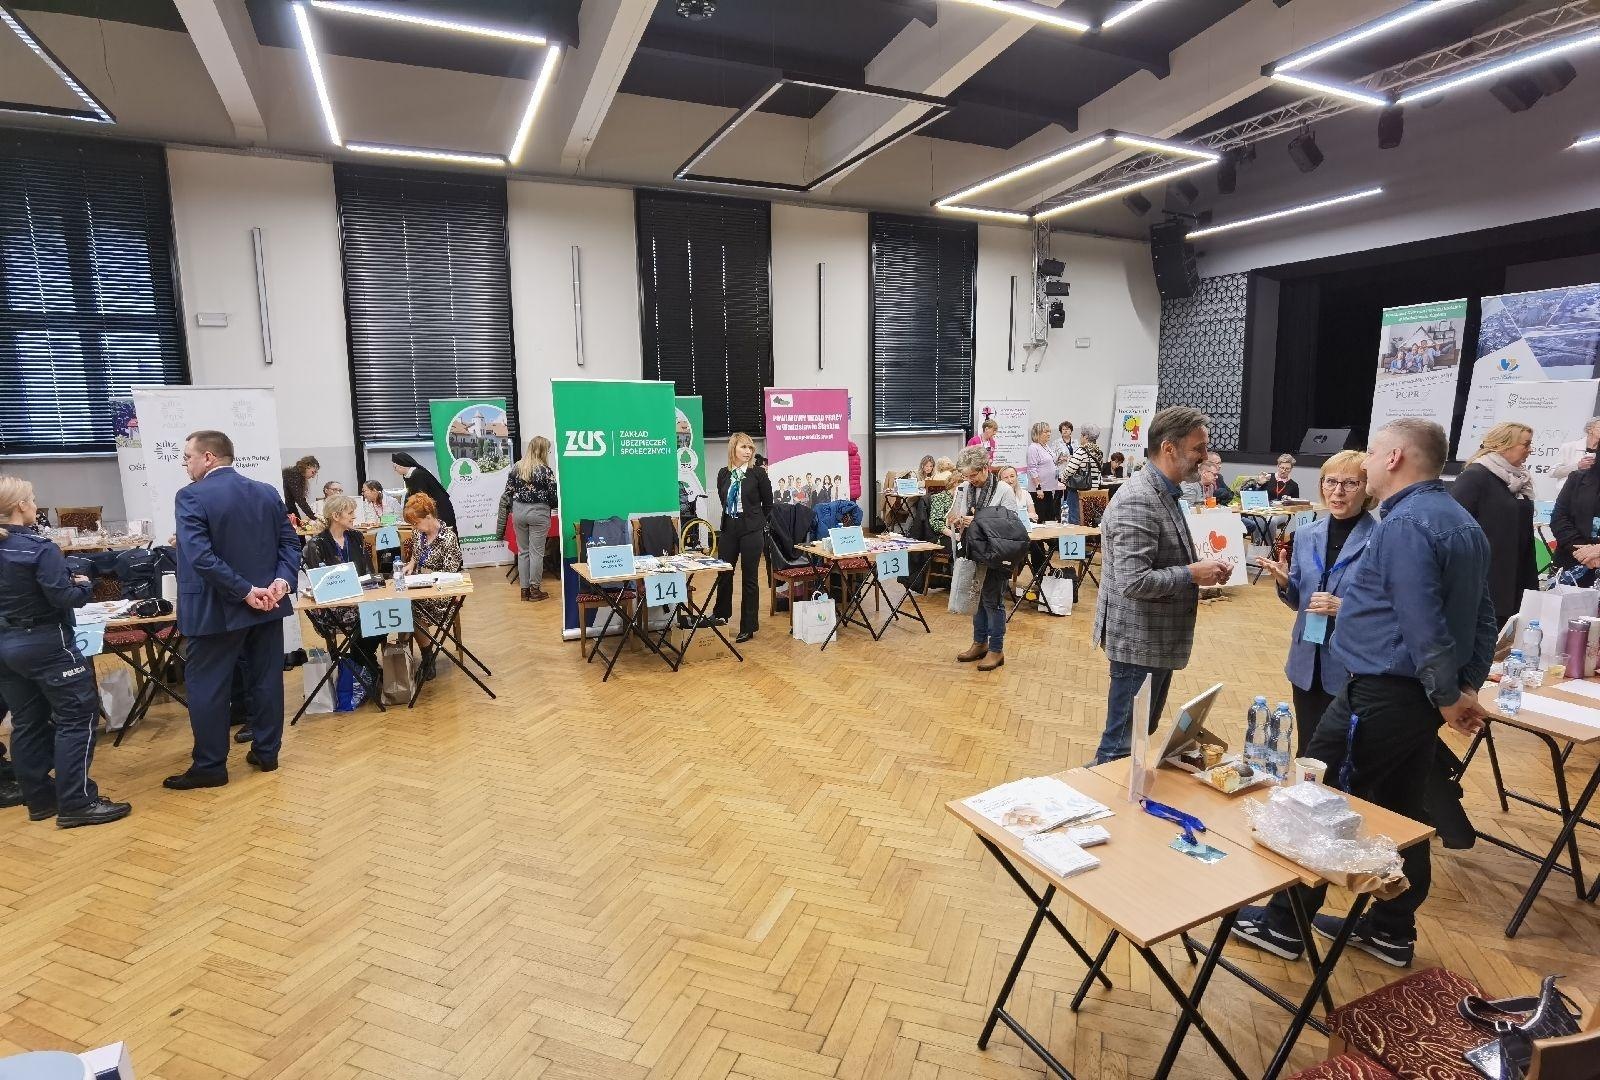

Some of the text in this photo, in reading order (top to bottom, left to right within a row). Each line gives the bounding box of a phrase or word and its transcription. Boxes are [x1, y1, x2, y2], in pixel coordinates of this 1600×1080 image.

[619, 430, 649, 438] ZAKŁAD
[562, 430, 607, 457] ZUS
[620, 438, 667, 447] UBEZPIECZEŃ
[620, 447, 671, 456] SPOŁECZNYCH
[380, 533, 389, 545] 4
[1064, 541, 1078, 556] 12
[882, 557, 900, 575] 13
[654, 581, 679, 601] 14
[372, 608, 402, 630] 15
[62, 665, 87, 678] POLICJA
